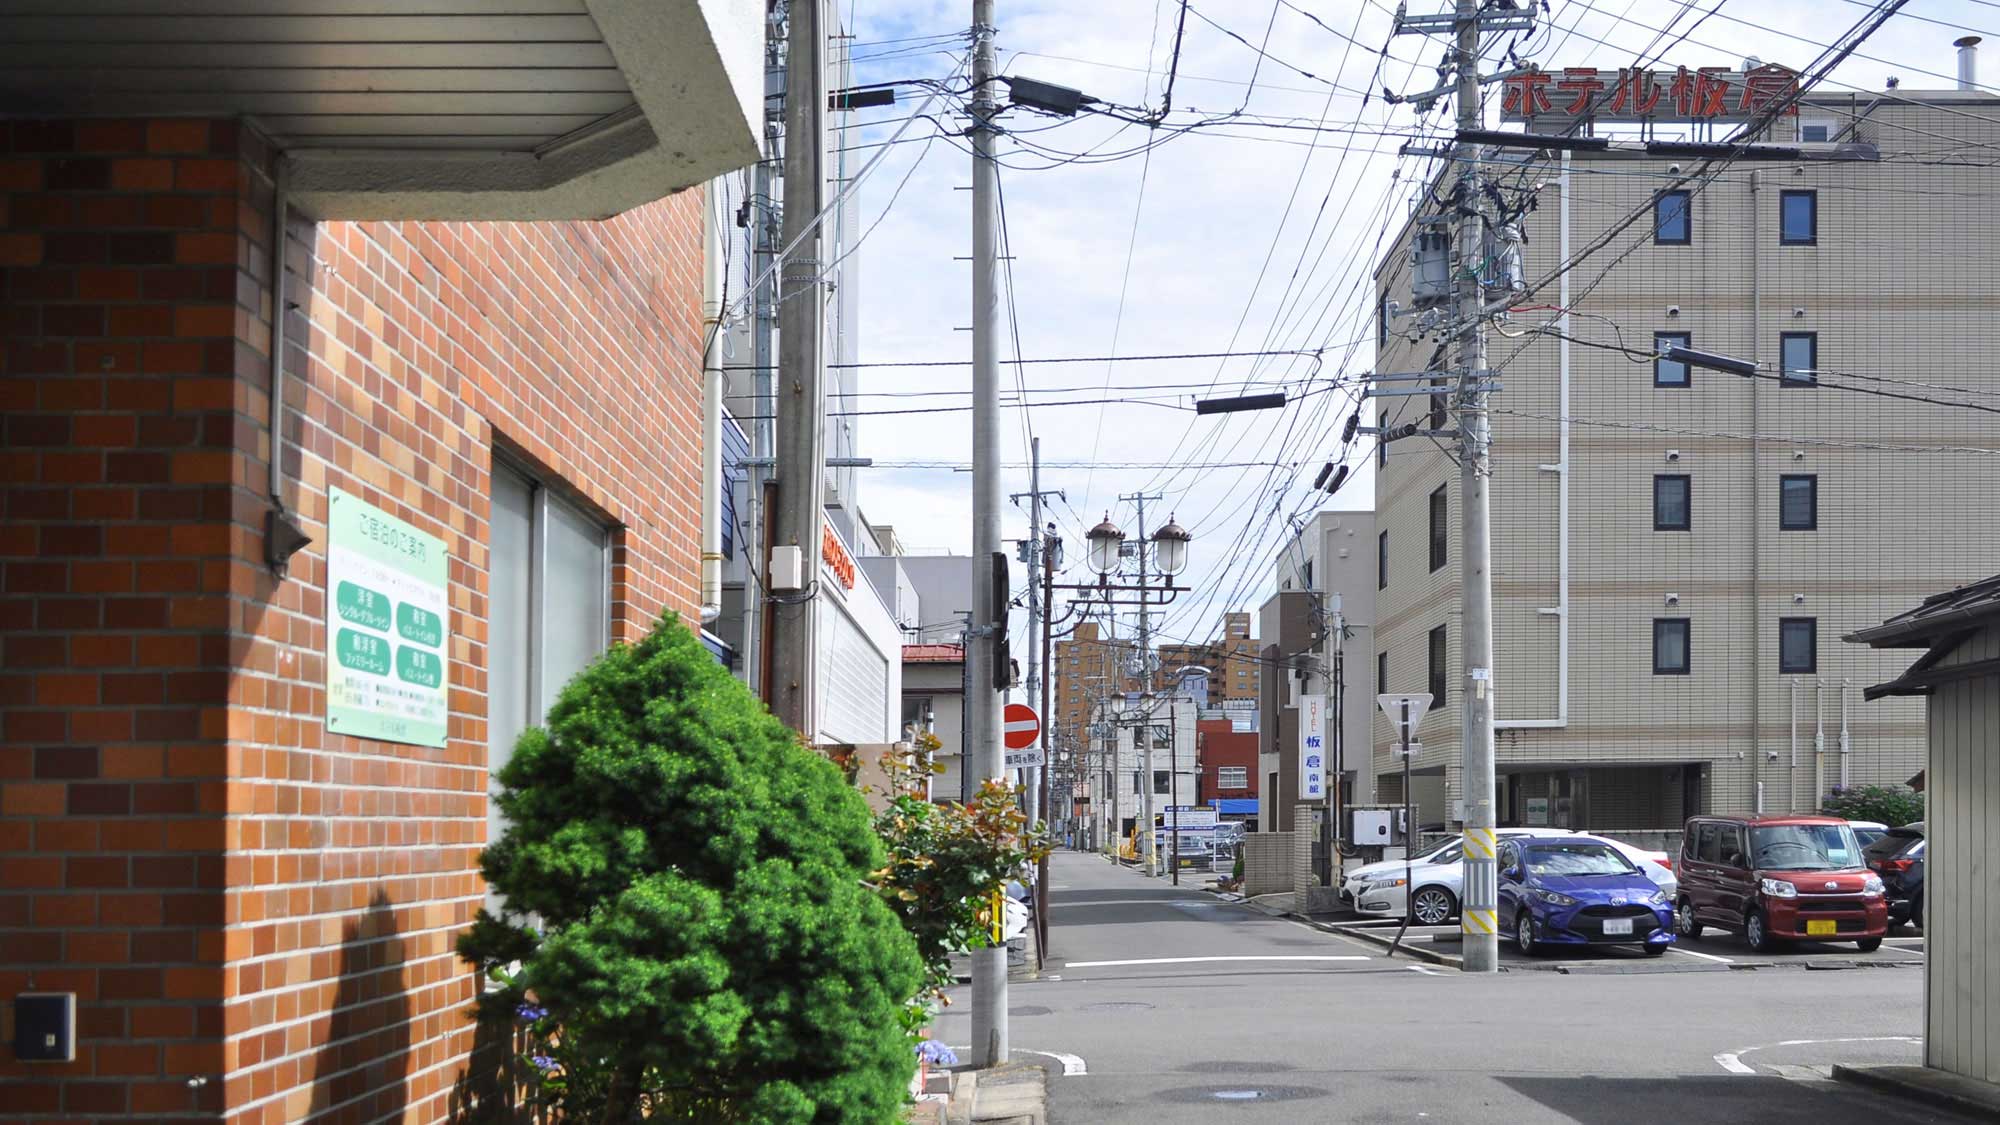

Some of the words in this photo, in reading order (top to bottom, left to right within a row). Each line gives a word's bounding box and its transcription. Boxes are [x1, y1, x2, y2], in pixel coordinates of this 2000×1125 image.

[1503, 62, 1801, 117] ホテル板倉
[359, 513, 426, 564] ご宿泊のご案内
